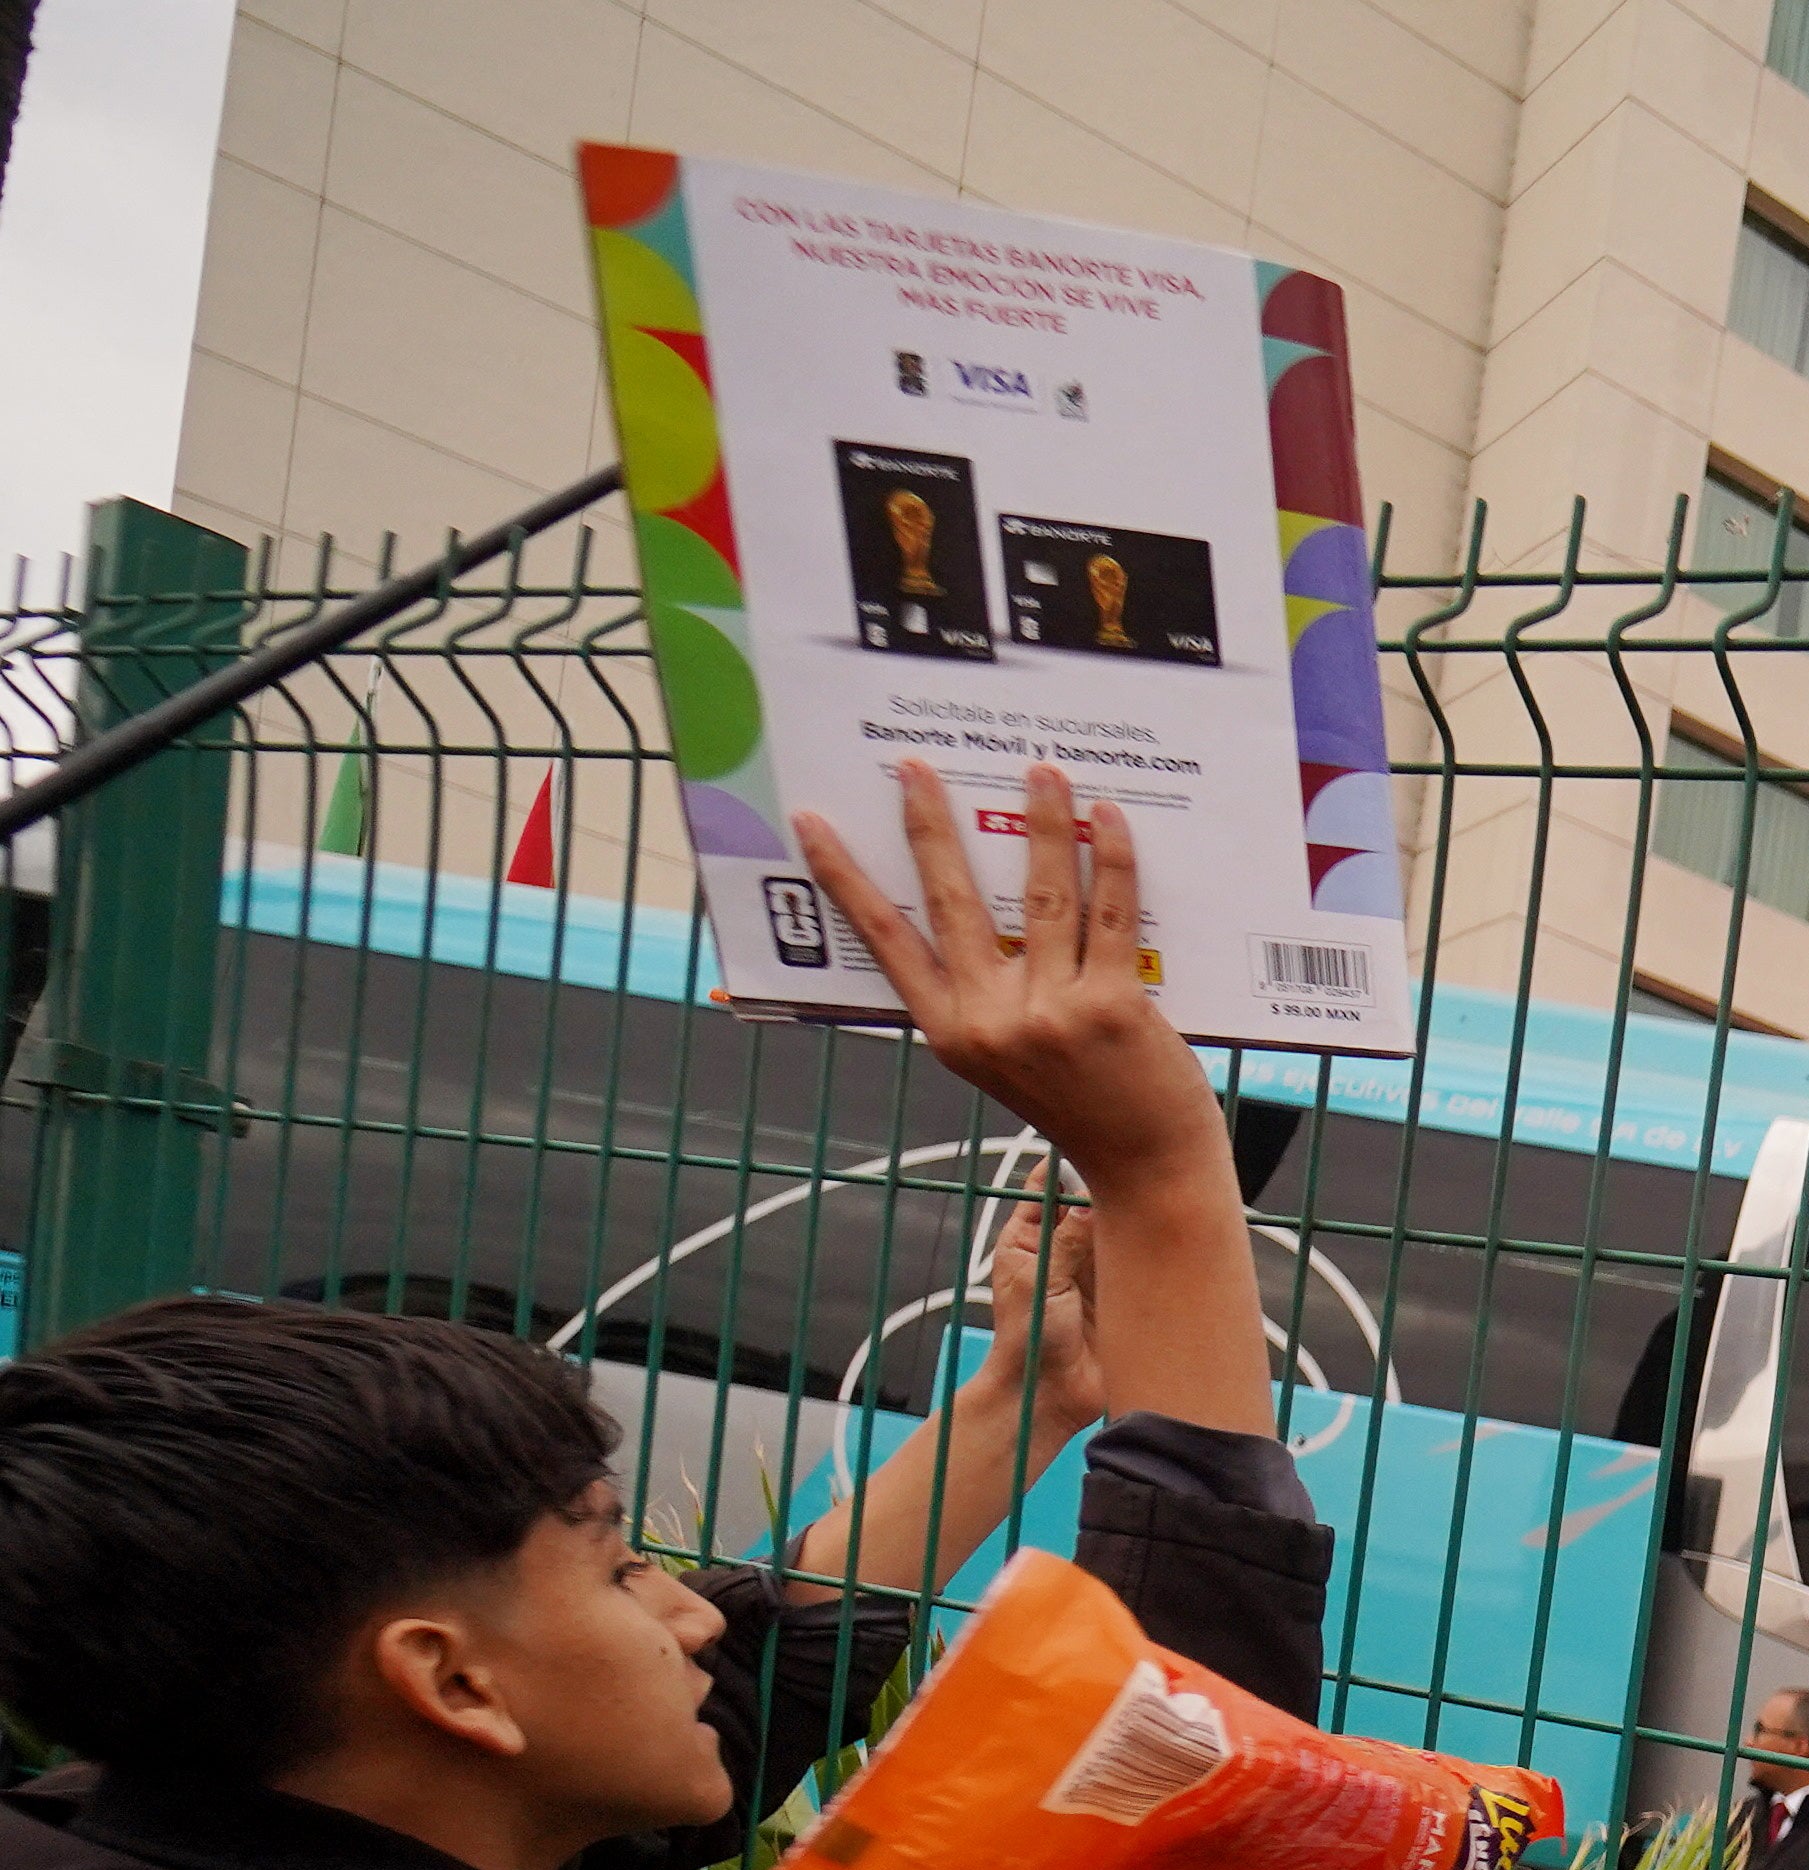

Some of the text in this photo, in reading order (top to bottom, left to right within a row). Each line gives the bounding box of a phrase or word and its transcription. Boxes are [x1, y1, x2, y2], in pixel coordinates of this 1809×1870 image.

[735, 197, 799, 226] CON
[808, 212, 861, 238] LAS
[864, 217, 1001, 264] TARJETAS
[1005, 244, 1135, 287] BANORTE
[791, 237, 922, 280] NUESTRA
[1061, 283, 1096, 311] SE
[1100, 291, 1162, 321] VIVE
[964, 300, 1069, 335] FUERTE
[951, 359, 1033, 399] VISA
[1028, 521, 1114, 548] BANORTE
[1165, 630, 1214, 654] VISA
[1000, 708, 1030, 728] en
[860, 719, 958, 748] Banorte
[1032, 740, 1048, 760] y
[1052, 741, 1202, 776] banorte.com
[1271, 1002, 1362, 1022] $ 99.00 MXN
